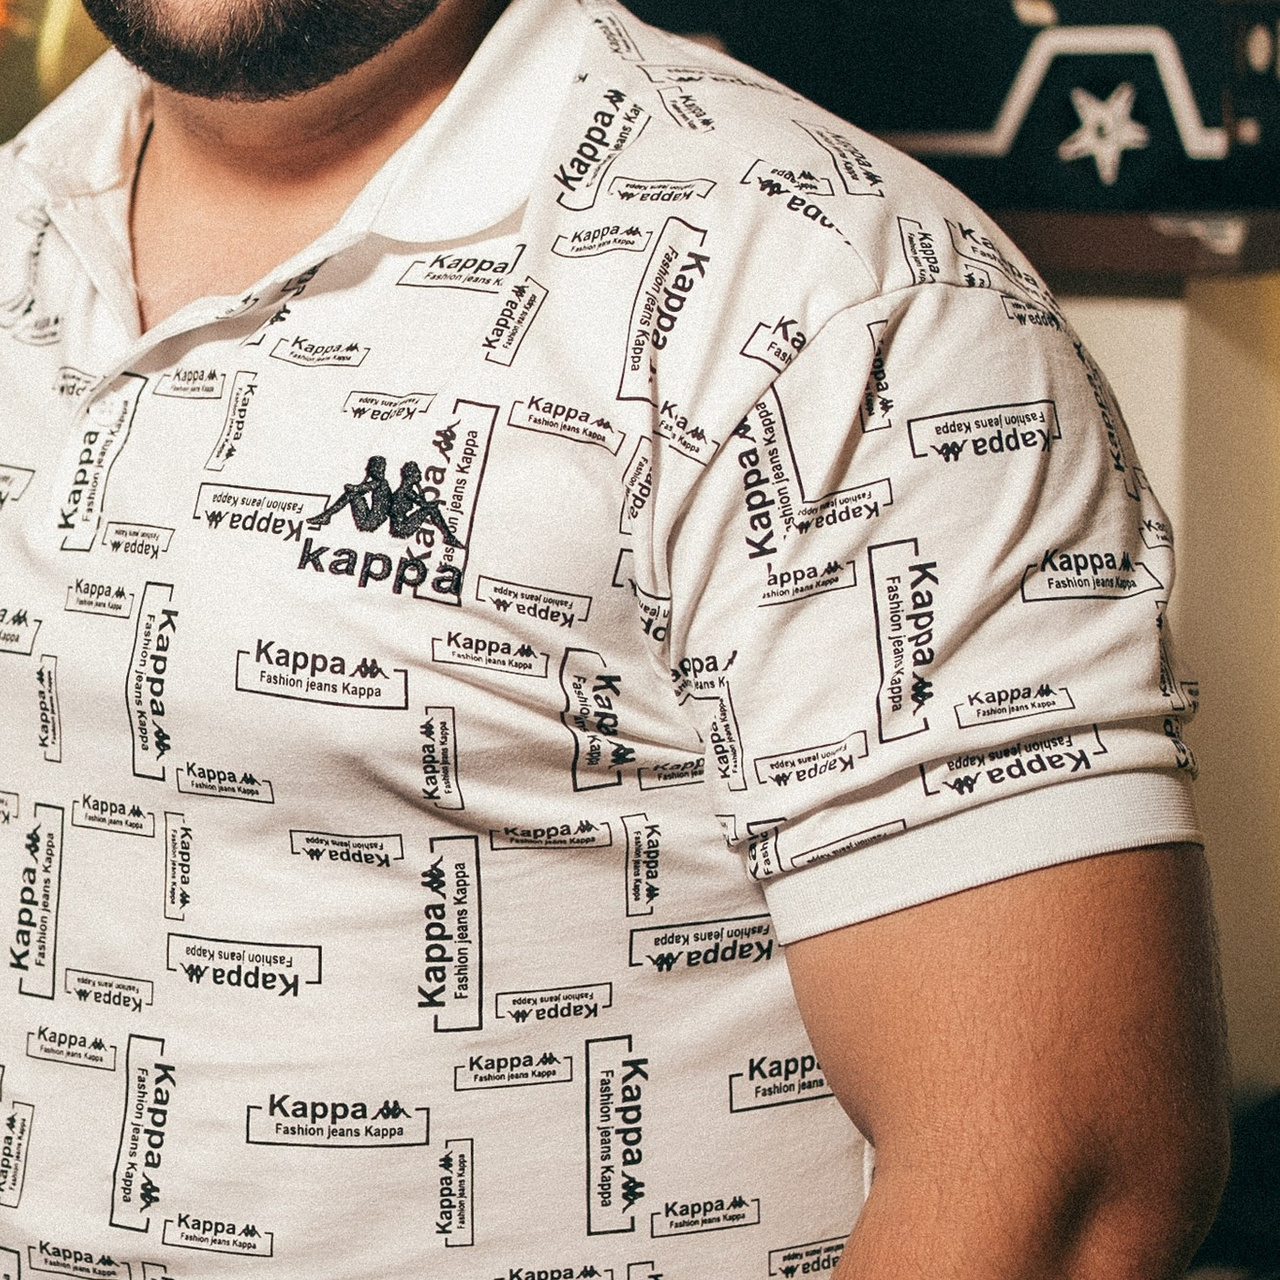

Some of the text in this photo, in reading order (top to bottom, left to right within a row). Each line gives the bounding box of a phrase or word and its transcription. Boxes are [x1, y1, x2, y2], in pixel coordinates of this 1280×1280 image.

[554, 111, 614, 191] Kappa
[640, 187, 694, 202] Kappa
[571, 224, 620, 244] Kappa
[431, 254, 509, 274] Kappa
[651, 252, 710, 351] Kappa
[482, 296, 520, 351] Kappa
[291, 336, 342, 353] Kappa
[173, 368, 206, 383] Kappa
[233, 384, 257, 441] Kappa
[528, 396, 591, 423] Kappa
[935, 411, 1046, 437] Fashion jeans Kappa
[973, 428, 1052, 456] Kappa
[58, 429, 100, 530] Kappa
[212, 494, 304, 513] Fashion jeans Kappa
[744, 451, 777, 559] Kappa
[816, 502, 880, 529] Kappa
[229, 512, 304, 541] Kappa
[124, 541, 159, 559] Kappa
[1040, 549, 1117, 575] Kappa
[298, 538, 463, 594] kappa
[767, 567, 818, 587] appa
[75, 579, 112, 599] Kappa
[517, 603, 574, 628] Kappa
[907, 561, 939, 668] Kappa
[447, 631, 511, 656] Kappa
[886, 575, 905, 713] Fashion jeans Kappa
[150, 609, 176, 718] Kappa
[255, 639, 347, 676] Kappa
[134, 613, 155, 751] Fashion jeans Kappa
[260, 671, 382, 699] Fashion jeans Kappa
[967, 686, 1032, 707] Kappa
[39, 690, 51, 748] Kappa
[186, 762, 238, 784] Kappa
[422, 745, 438, 801] Kappa
[796, 754, 855, 783] Kappa
[987, 749, 1092, 785] Kappa
[82, 794, 127, 816] Kappa
[503, 824, 571, 840] Kappa
[179, 827, 193, 886] Kappa
[329, 848, 391, 867] Kappa
[645, 825, 662, 880] Kappa
[34, 832, 55, 967] Fashion jeans Kappa
[9, 867, 39, 971] Kappa
[453, 862, 471, 999] Fashion jeans Kappa
[185, 946, 293, 968] Fashion jeans Kappa
[417, 904, 454, 1008] Kappa
[687, 940, 773, 967] Kappa
[212, 967, 300, 997] Kappa
[93, 991, 143, 1013] Kappa
[536, 1003, 599, 1021] Kappa
[37, 1026, 88, 1048] Kappa
[470, 1053, 534, 1074] Kappa
[144, 1063, 176, 1169] Kappa
[269, 1094, 368, 1124] Kappa
[616, 1059, 649, 1167] Kappa
[275, 1123, 404, 1140] Fashion jeans Kappa
[598, 1069, 614, 1208] Fashion jeans Kappa
[436, 1175, 453, 1234] Kappa
[665, 1197, 725, 1219] Kappa
[177, 1212, 237, 1237] Kappa
[39, 1240, 94, 1265] Kappa
[801, 1256, 839, 1275] appa
